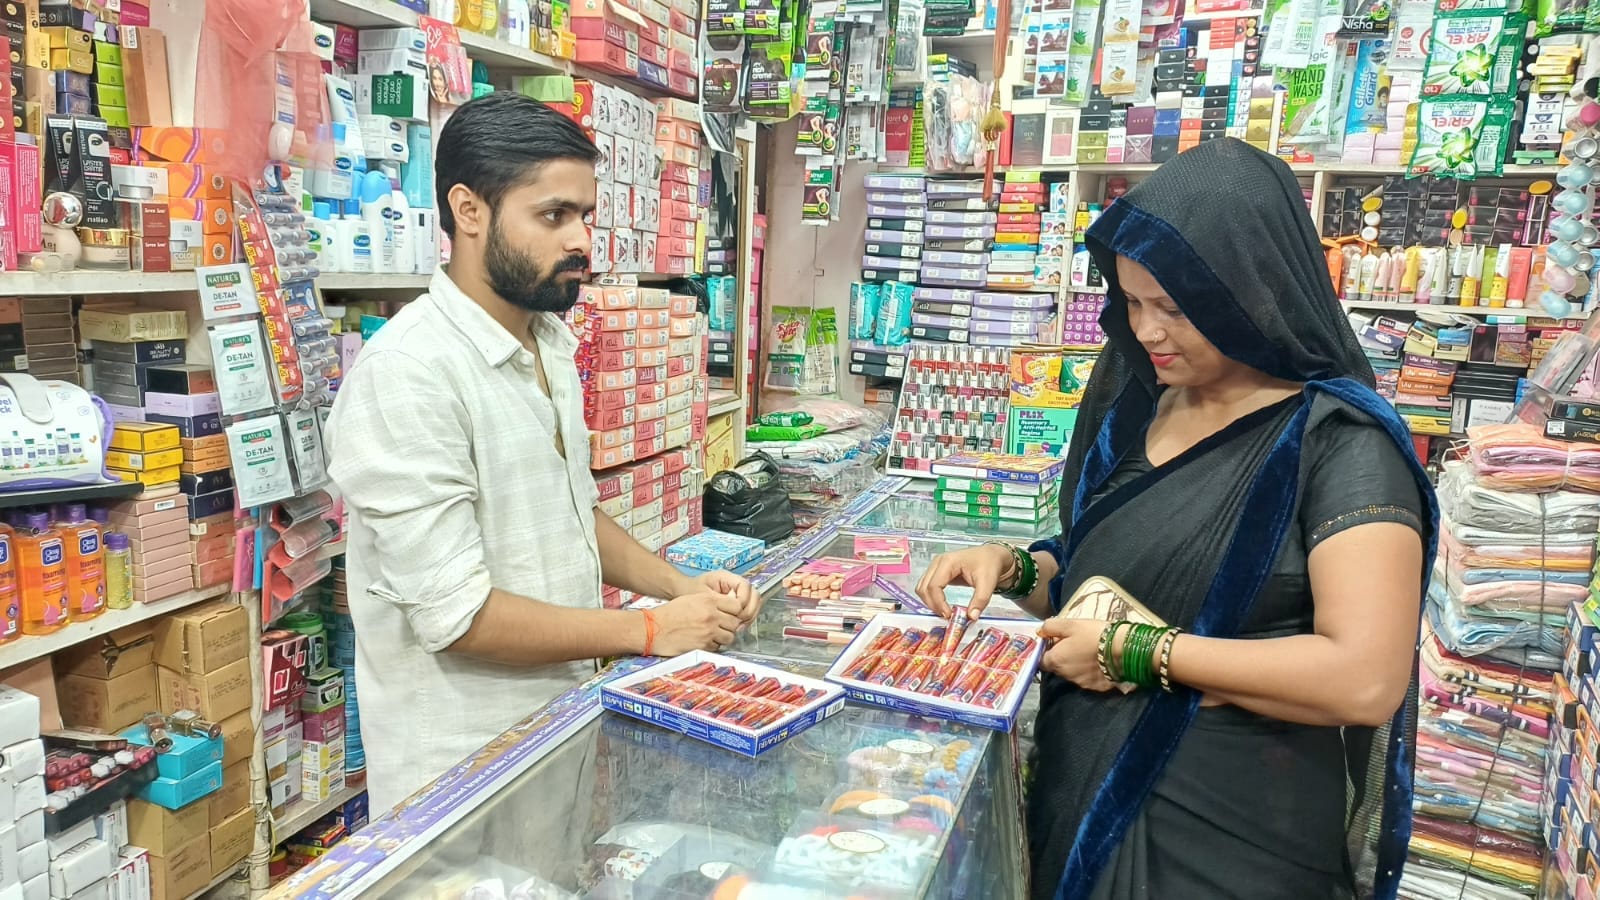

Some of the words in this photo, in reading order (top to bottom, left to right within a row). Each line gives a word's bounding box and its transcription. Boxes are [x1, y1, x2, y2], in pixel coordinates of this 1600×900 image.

[1342, 16, 1374, 31] Nisha
[1447, 31, 1490, 45] ARIEL
[1309, 48, 1329, 62] gic
[1294, 69, 1326, 84] HAND
[1293, 83, 1323, 98] WASH
[1365, 71, 1378, 106] Guard
[1431, 116, 1474, 128] ARIEL
[207, 273, 240, 285] NATURE'S
[213, 291, 238, 300] DE-TAN
[227, 352, 254, 362] DE-TAN
[1020, 411, 1044, 419] PLIX
[243, 429, 271, 442] NATURE'S
[245, 446, 274, 458] DE-TAN
